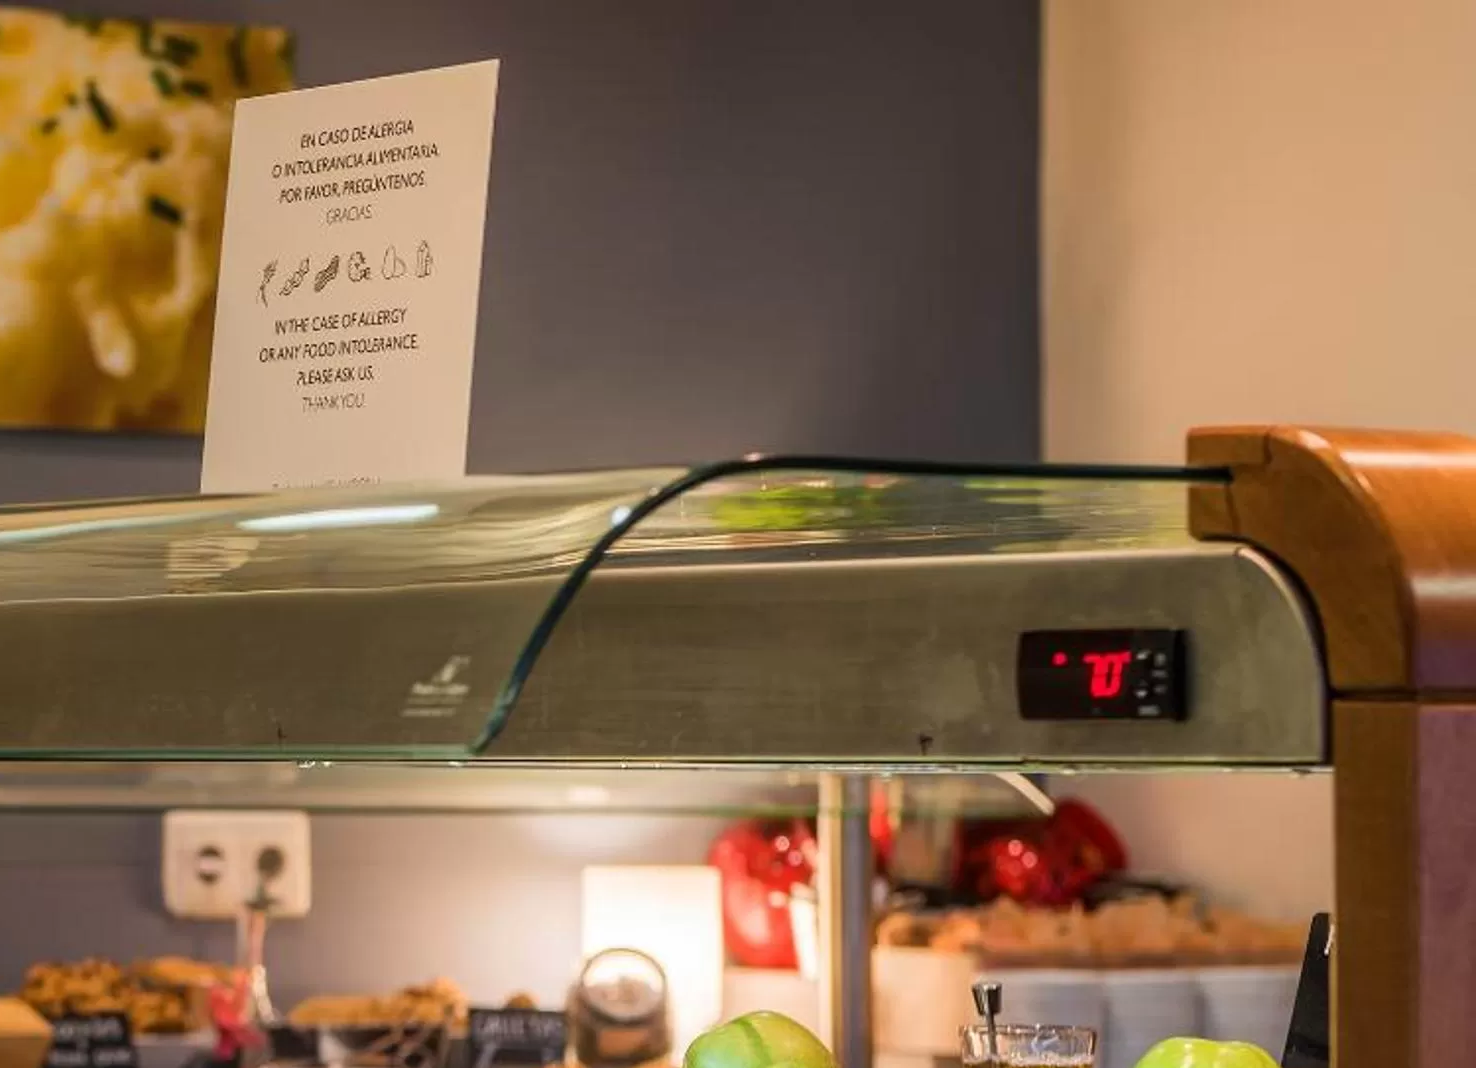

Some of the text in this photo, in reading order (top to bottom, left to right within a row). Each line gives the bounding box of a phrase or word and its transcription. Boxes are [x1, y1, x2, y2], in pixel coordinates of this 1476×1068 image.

[301, 120, 414, 148] EN CASO DE ALERGIA
[272, 164, 282, 178] O
[284, 153, 363, 177] INTOLERANCIA
[279, 188, 302, 203] POR
[275, 308, 407, 335] IN THE CASE OF ALLERGY
[259, 347, 276, 362] OR
[277, 344, 301, 360] ANY
[302, 341, 336, 358] FOOD
[296, 368, 333, 386] PLEASE
[334, 366, 355, 382] ASK
